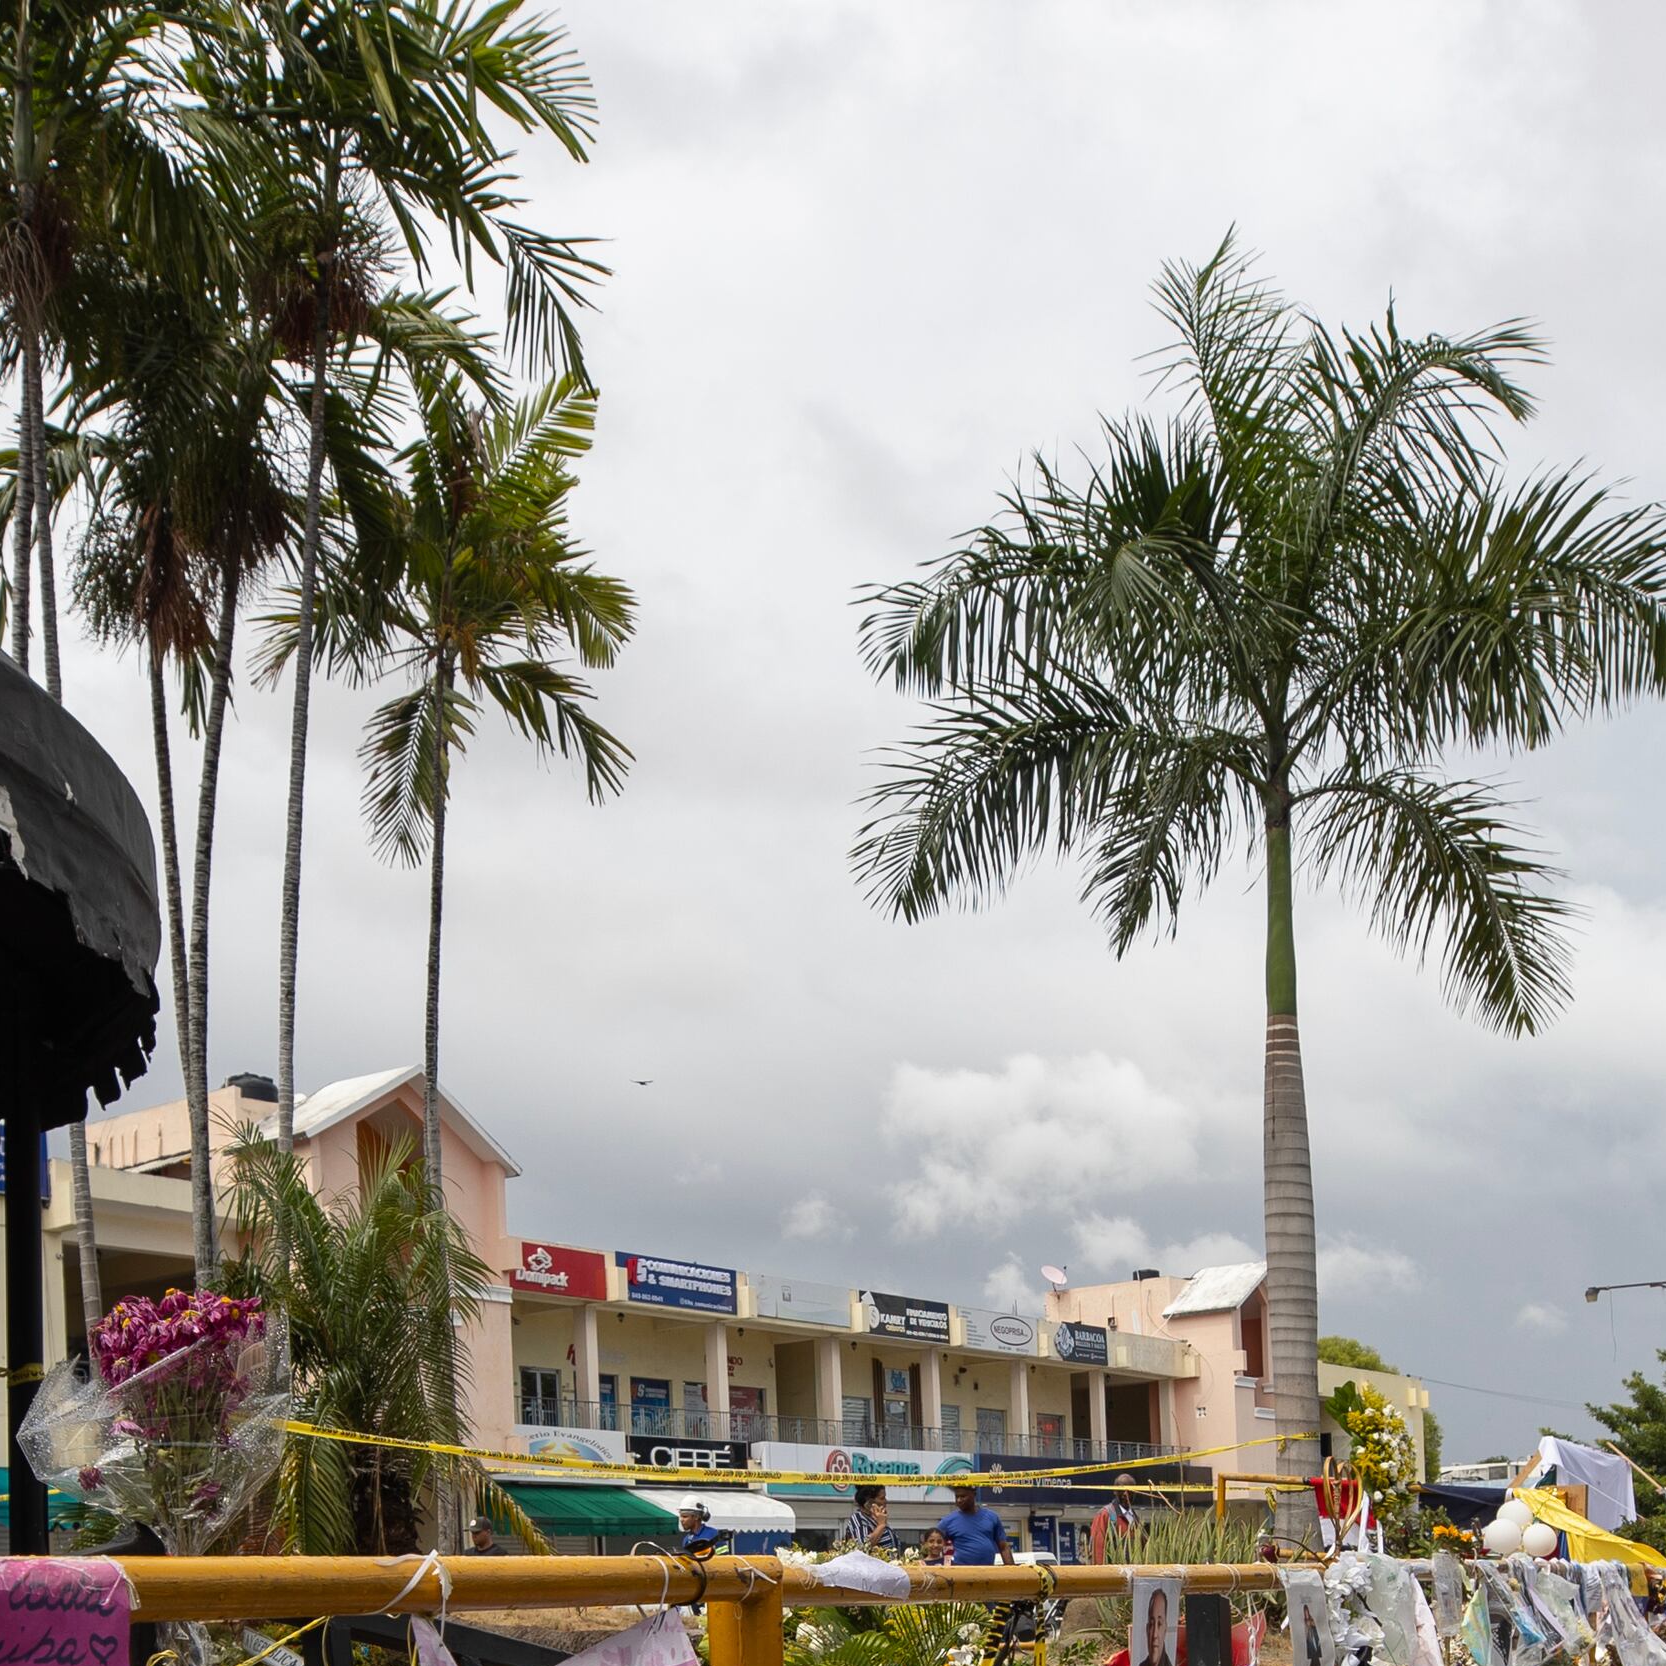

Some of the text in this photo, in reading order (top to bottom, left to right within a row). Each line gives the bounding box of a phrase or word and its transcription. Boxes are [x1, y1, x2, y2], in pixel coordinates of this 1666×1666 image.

[515, 1267, 569, 1289] Domipack
[658, 1275, 732, 1297] SMARTPHONES
[1074, 1330, 1105, 1343] BARBACOA
[851, 1452, 921, 1476] Rosanna
